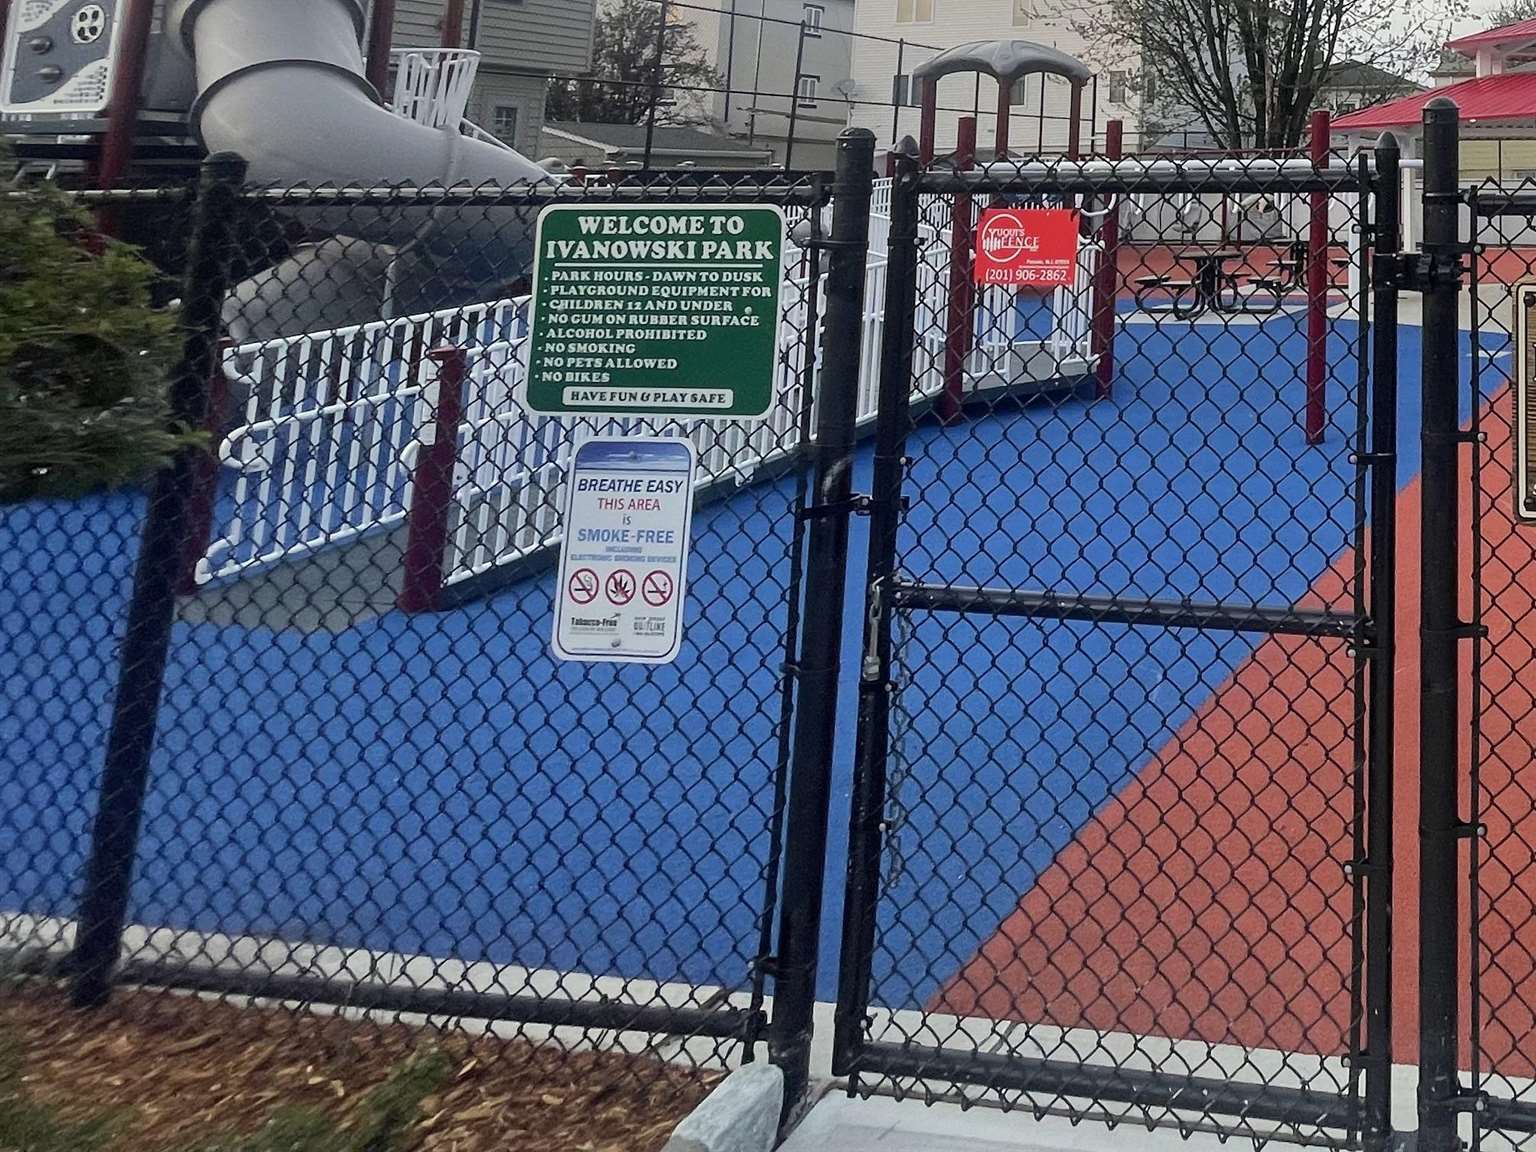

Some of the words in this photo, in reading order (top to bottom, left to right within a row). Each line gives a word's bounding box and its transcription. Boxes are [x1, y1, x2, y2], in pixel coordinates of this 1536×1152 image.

[578, 216, 704, 235] WELCOME
[710, 216, 744, 235] TO
[1002, 237, 1039, 247] FENCE
[546, 241, 696, 260] IVANOWSKI
[701, 241, 774, 260] PARK
[552, 272, 591, 282] PARK
[594, 272, 643, 282] HOURS
[652, 272, 697, 282] DAWN
[700, 272, 720, 282] TO
[721, 272, 763, 282] DUSK
[986, 268, 1012, 281] (201)
[1015, 268, 1067, 281] 906-2862
[550, 286, 649, 297] PLAYGROUND
[651, 286, 740, 297] EQUIPMENT
[742, 286, 771, 297] FOR
[550, 300, 624, 311] CHILDREN
[626, 300, 642, 311] 12
[644, 300, 678, 311] AND
[680, 300, 733, 311] UNDER
[549, 314, 568, 325] NO
[571, 314, 605, 325] GUM
[606, 314, 626, 325] ON
[629, 314, 689, 325] RUBBER
[691, 315, 759, 326] SURFACE
[546, 329, 614, 340] ALCOHOL
[616, 329, 707, 340] PROHIBITED
[545, 343, 566, 353] NO
[568, 343, 636, 353] SMOKING
[543, 358, 564, 368] NO
[567, 358, 603, 368] PETS
[604, 358, 678, 369] ALLOWED
[542, 372, 563, 382] NO
[565, 372, 610, 382] BIKES
[570, 392, 607, 403] HAVE
[609, 392, 638, 403] FUN
[640, 392, 651, 403] &
[653, 392, 688, 403] PLAY
[690, 392, 726, 403] SAFE
[578, 479, 643, 493] BREATHE
[647, 479, 684, 493] EASY
[598, 498, 625, 510] THIS
[628, 498, 661, 510] AREA
[623, 514, 631, 525] is
[577, 528, 674, 544] SMOKE-FREE
